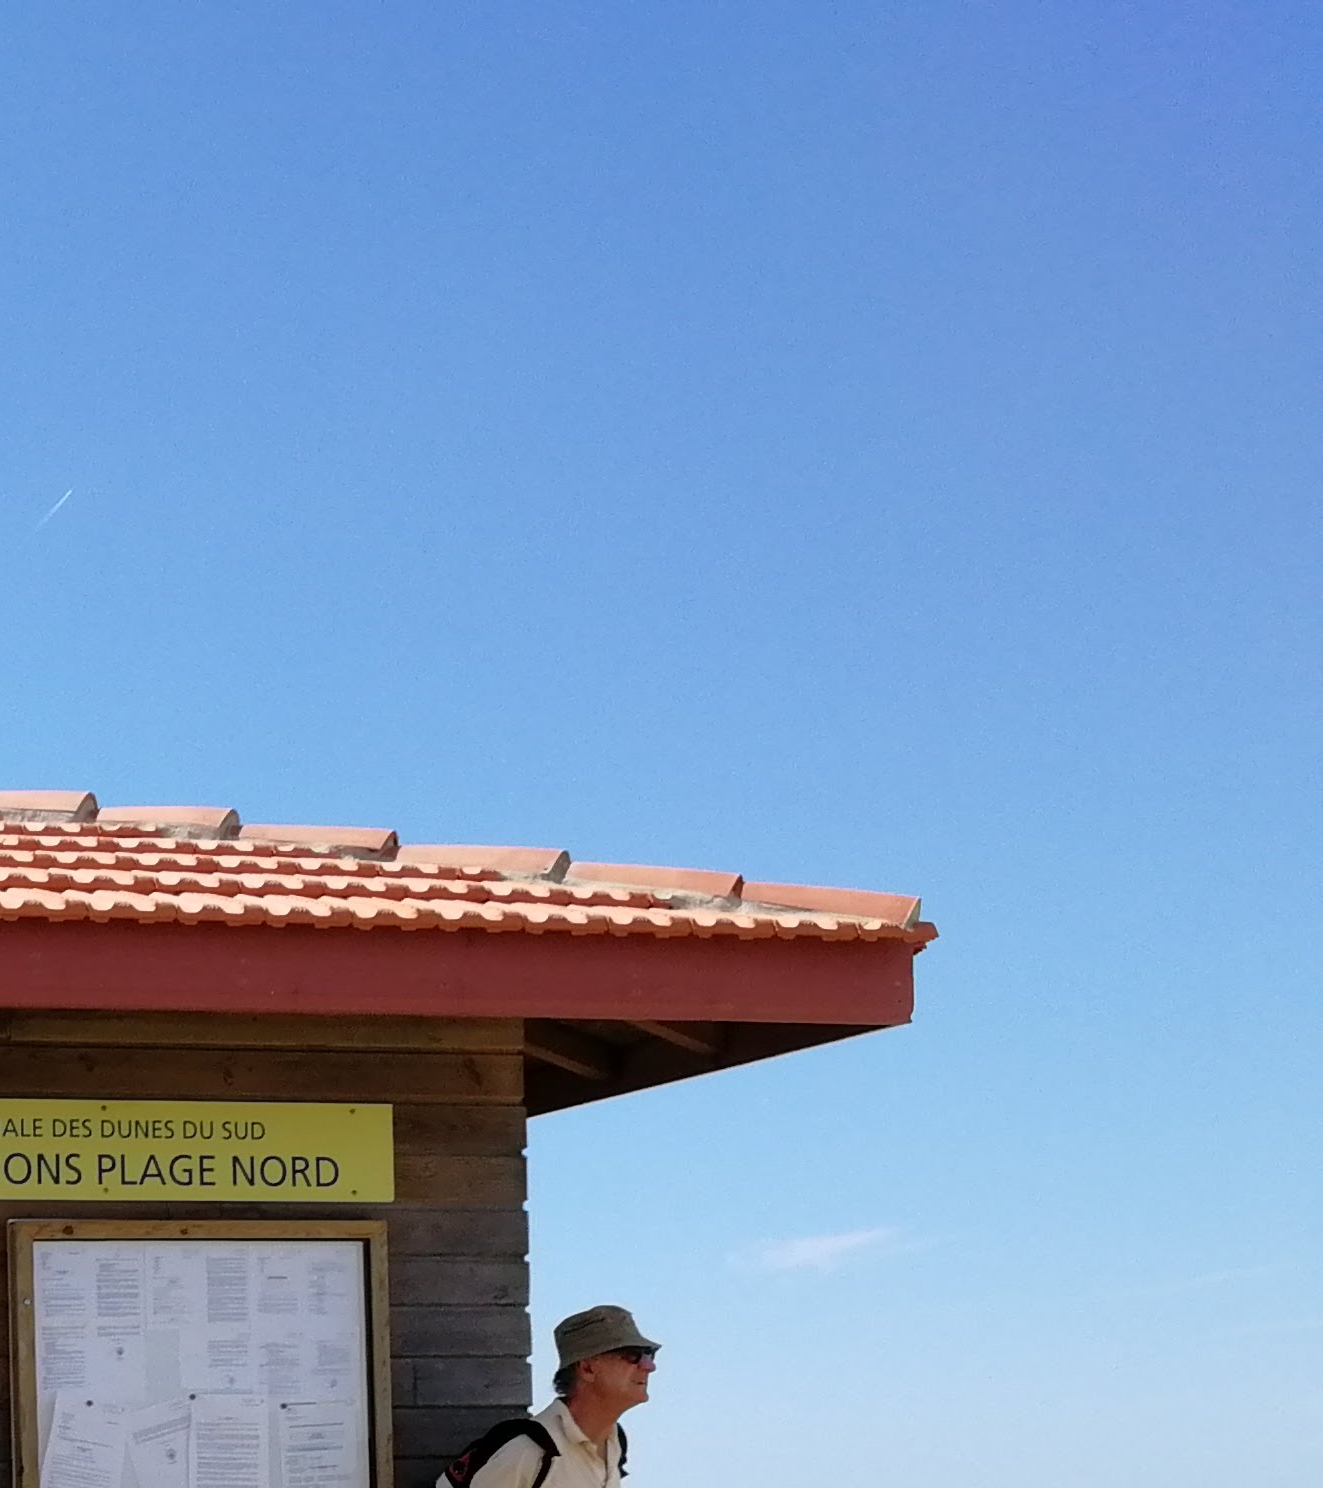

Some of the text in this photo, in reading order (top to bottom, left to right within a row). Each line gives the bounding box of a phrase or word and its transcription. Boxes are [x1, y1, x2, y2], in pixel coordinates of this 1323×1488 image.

[52, 1118, 93, 1138] DES
[100, 1119, 174, 1139] DUNES
[182, 1120, 214, 1140] DU
[221, 1121, 266, 1141] SUD
[97, 1154, 216, 1187] PLAGE
[231, 1156, 340, 1187] NORD
